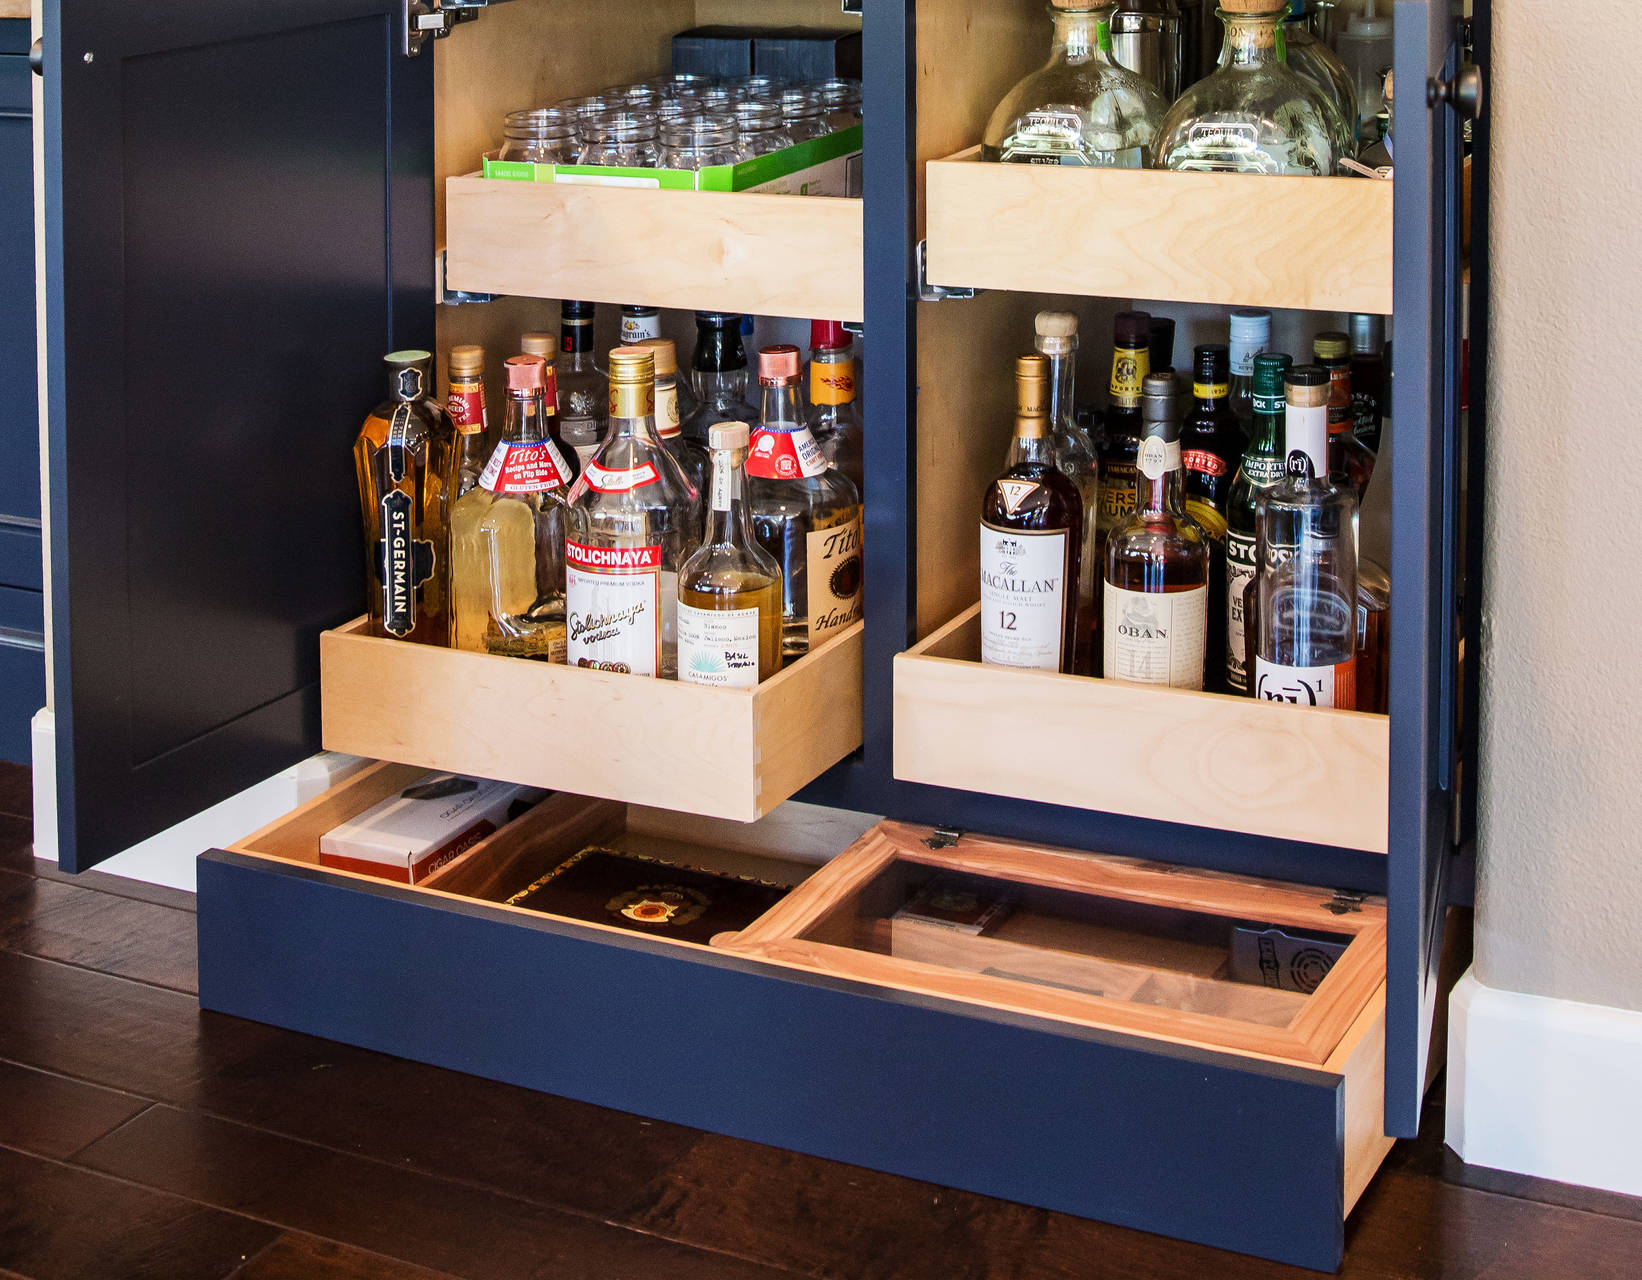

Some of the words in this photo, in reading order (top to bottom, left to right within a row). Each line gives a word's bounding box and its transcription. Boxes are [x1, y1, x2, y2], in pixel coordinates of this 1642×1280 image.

[1111, 383, 1142, 391] MPORTE
[509, 447, 547, 465] Tito's
[1183, 455, 1219, 470] PORTED
[505, 463, 526, 475] Recipe
[526, 460, 539, 470] and
[538, 460, 553, 469] More
[1245, 459, 1287, 471] IMPORTE
[513, 472, 523, 480] on
[523, 470, 535, 480] Flip
[535, 468, 548, 477] Side
[1248, 469, 1268, 478] EXTRA
[1270, 469, 1286, 478] DRY
[1009, 485, 1021, 497] 12
[566, 542, 652, 566] STOLICHNAYA
[1228, 541, 1257, 563] STO
[392, 511, 407, 613] ST-GERMAIN
[1000, 561, 1019, 576] The
[981, 568, 1055, 593] MACALLAN
[570, 601, 645, 641] Stolichnaya
[999, 610, 1018, 631] 12
[583, 628, 621, 645] vodka
[1117, 624, 1168, 639] OBAN
[688, 670, 728, 682] CASAMIGOS
[428, 850, 455, 874] CIGAR
